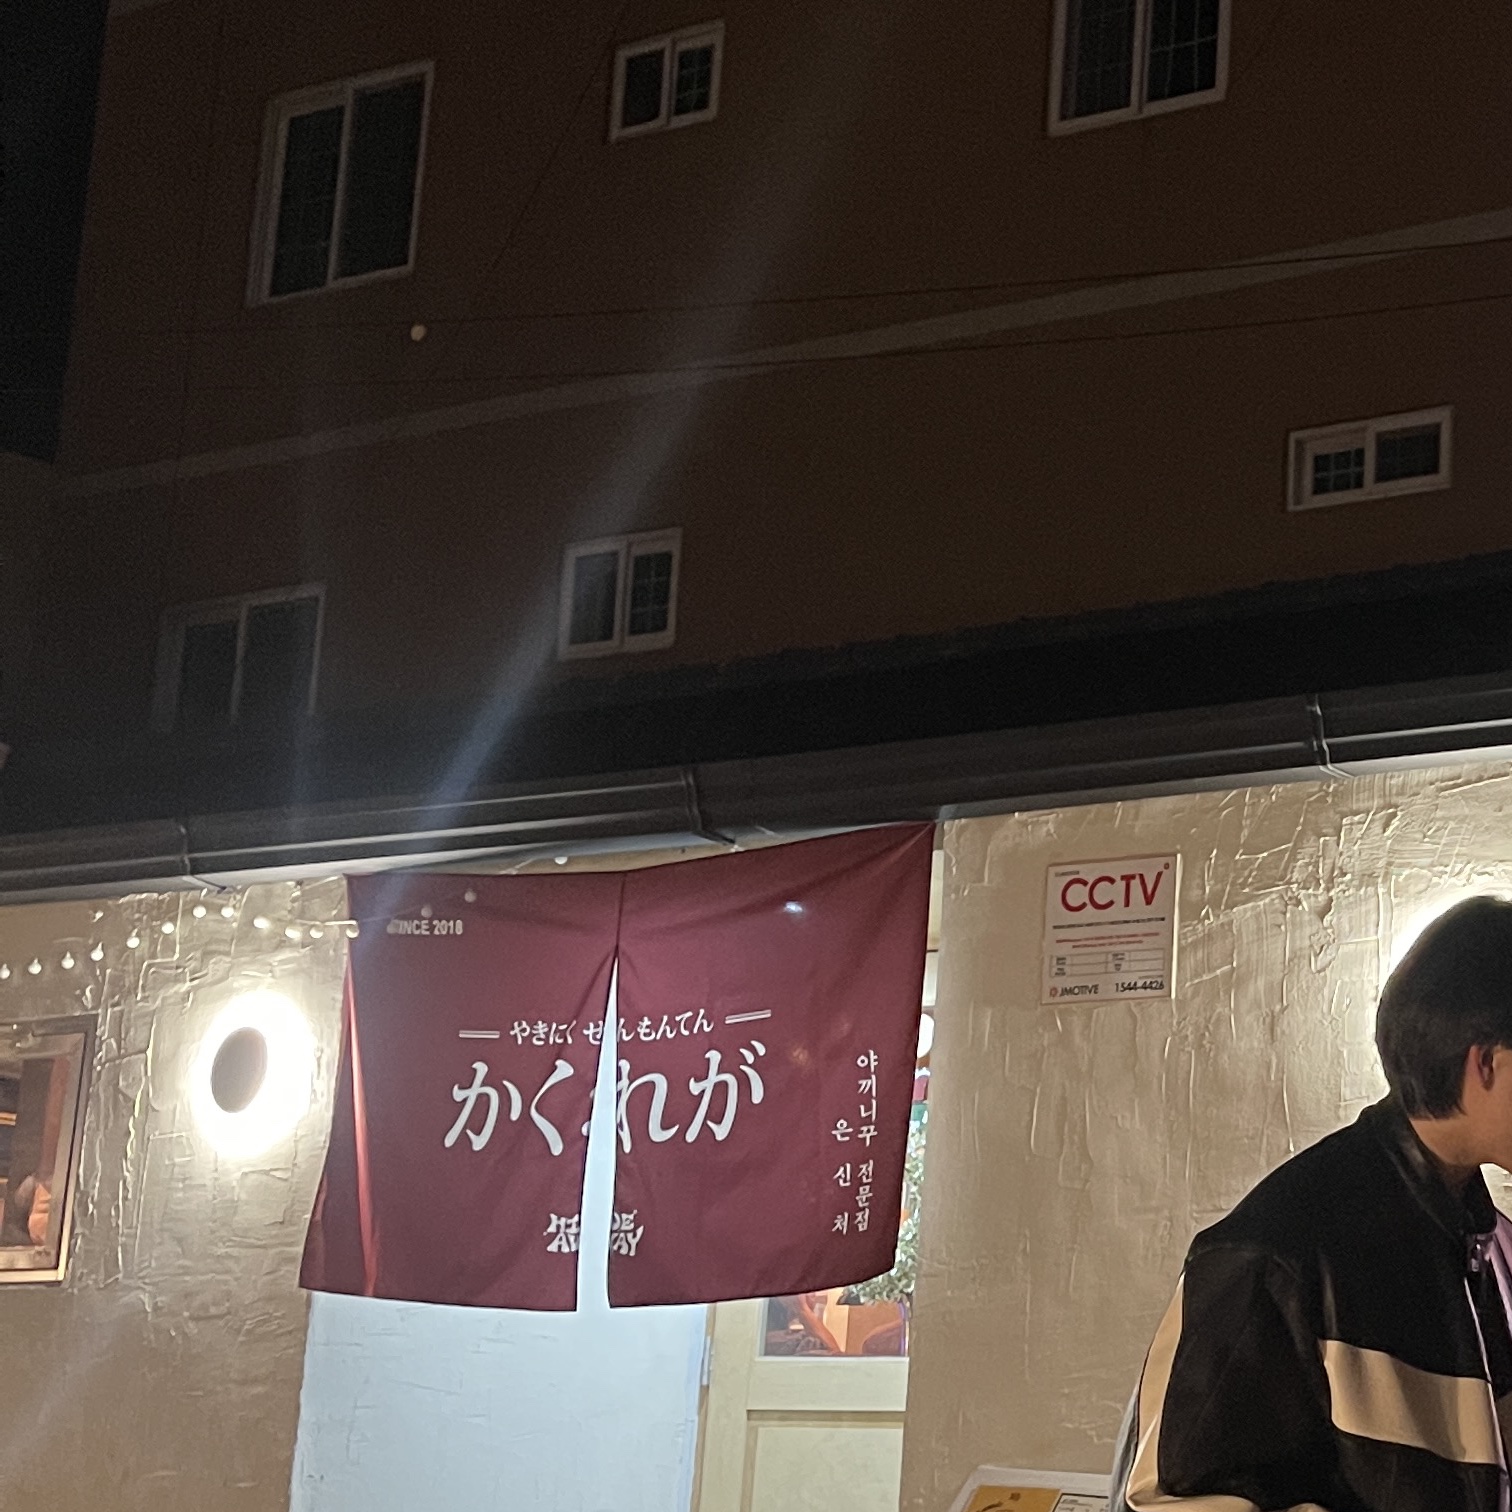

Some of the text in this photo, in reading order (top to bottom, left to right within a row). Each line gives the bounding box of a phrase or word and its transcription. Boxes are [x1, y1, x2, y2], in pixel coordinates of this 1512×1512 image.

[1061, 871, 1164, 912] CCTV
[444, 1040, 766, 1156] かくれが
[855, 1050, 878, 1232] 야끼니꾸 전문점
